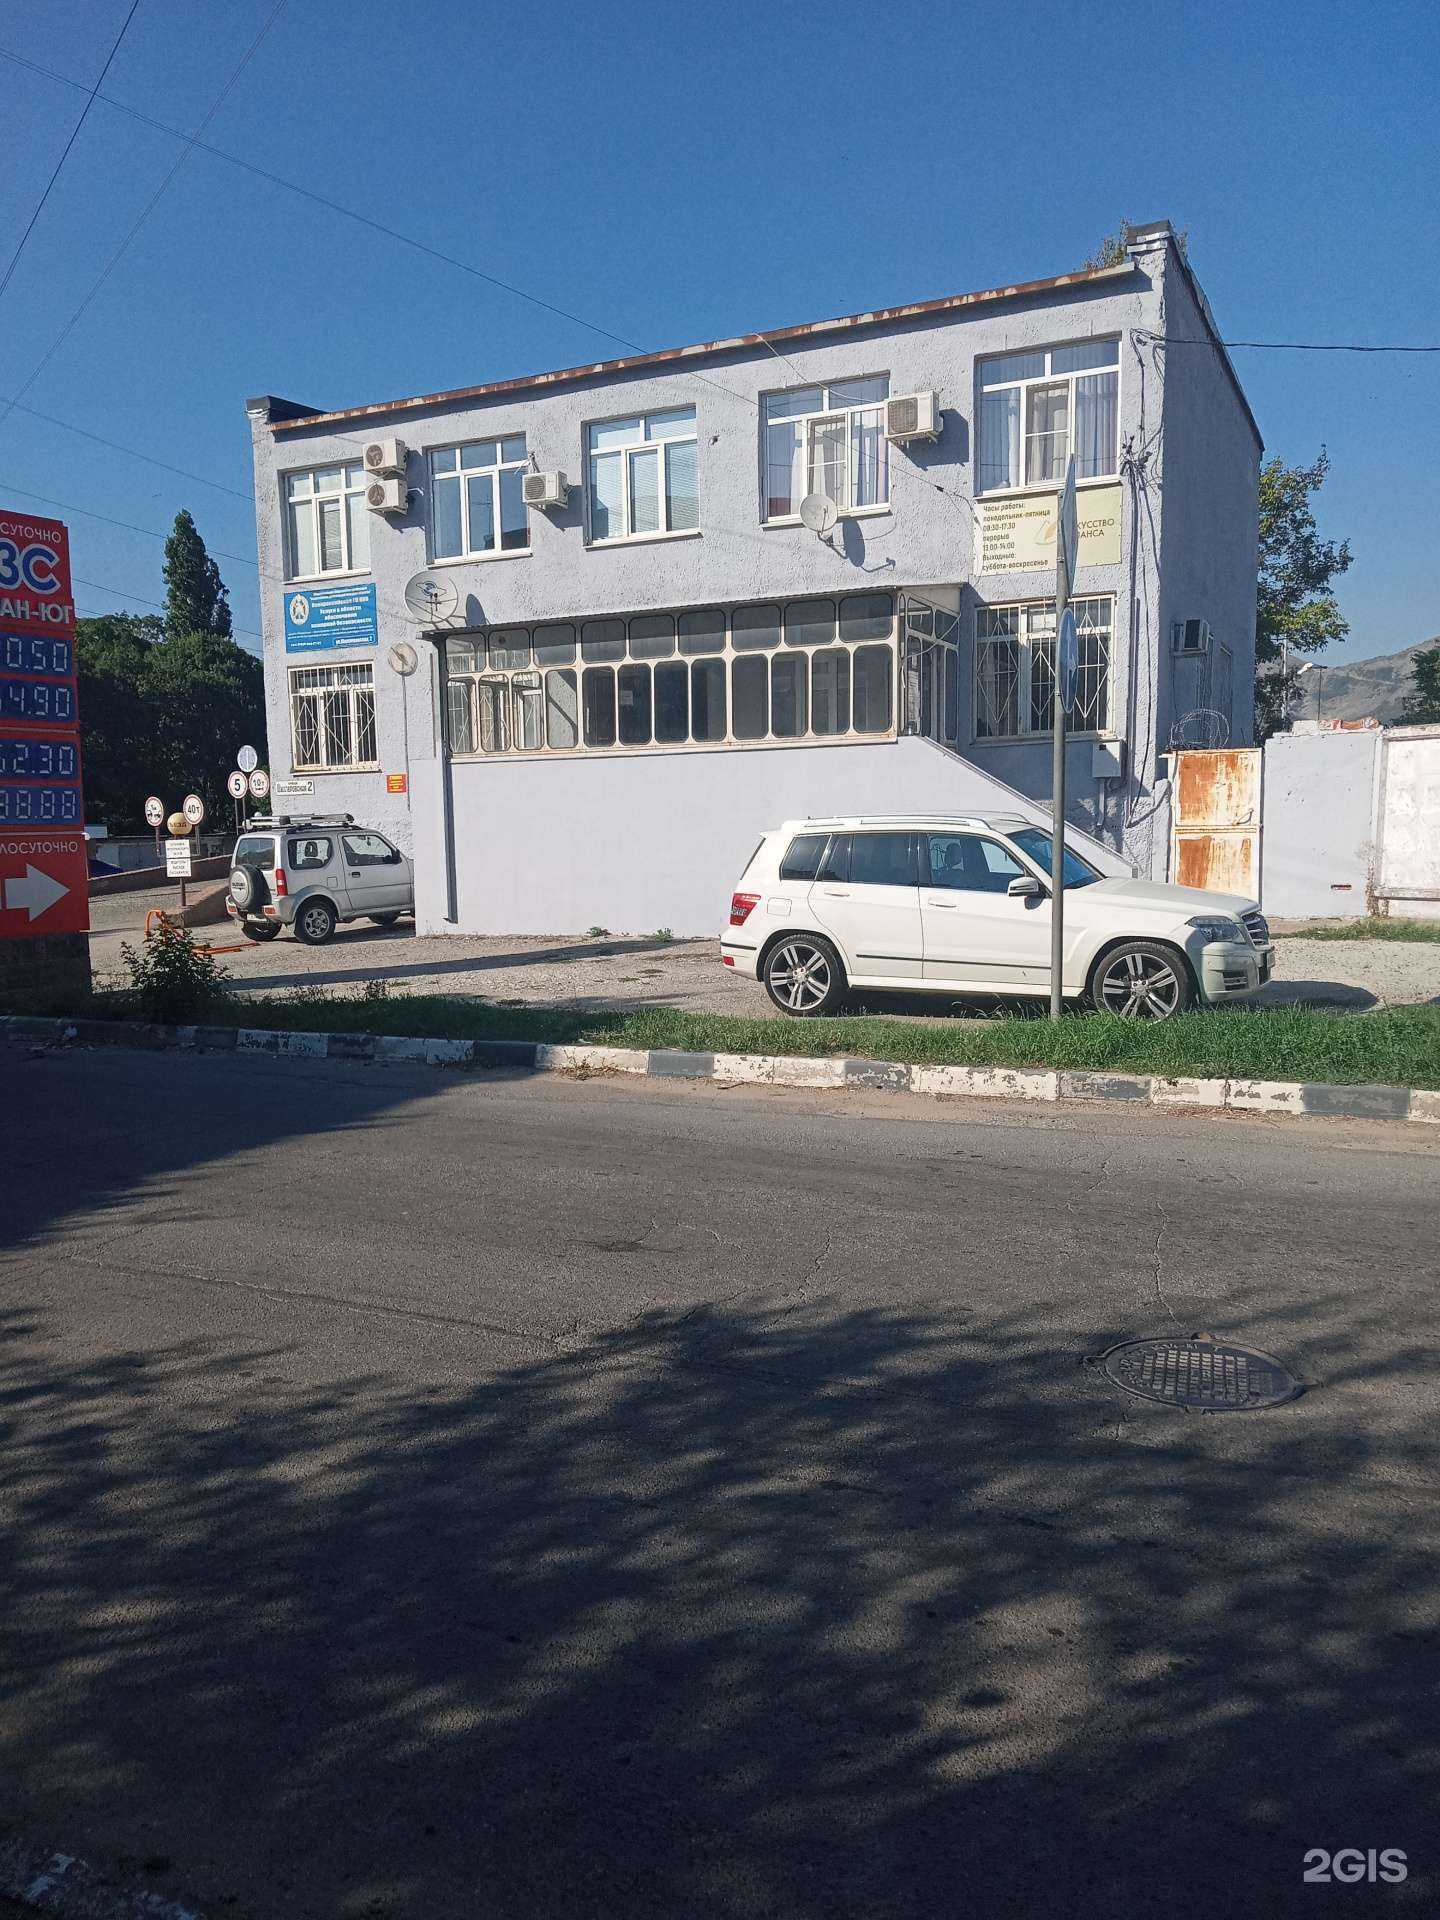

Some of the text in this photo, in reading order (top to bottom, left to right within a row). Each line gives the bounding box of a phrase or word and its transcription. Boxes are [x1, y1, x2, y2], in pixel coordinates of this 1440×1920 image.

[0, 686, 70, 717] 4.90
[234, 778, 241, 791] 5
[307, 781, 313, 791] 2
